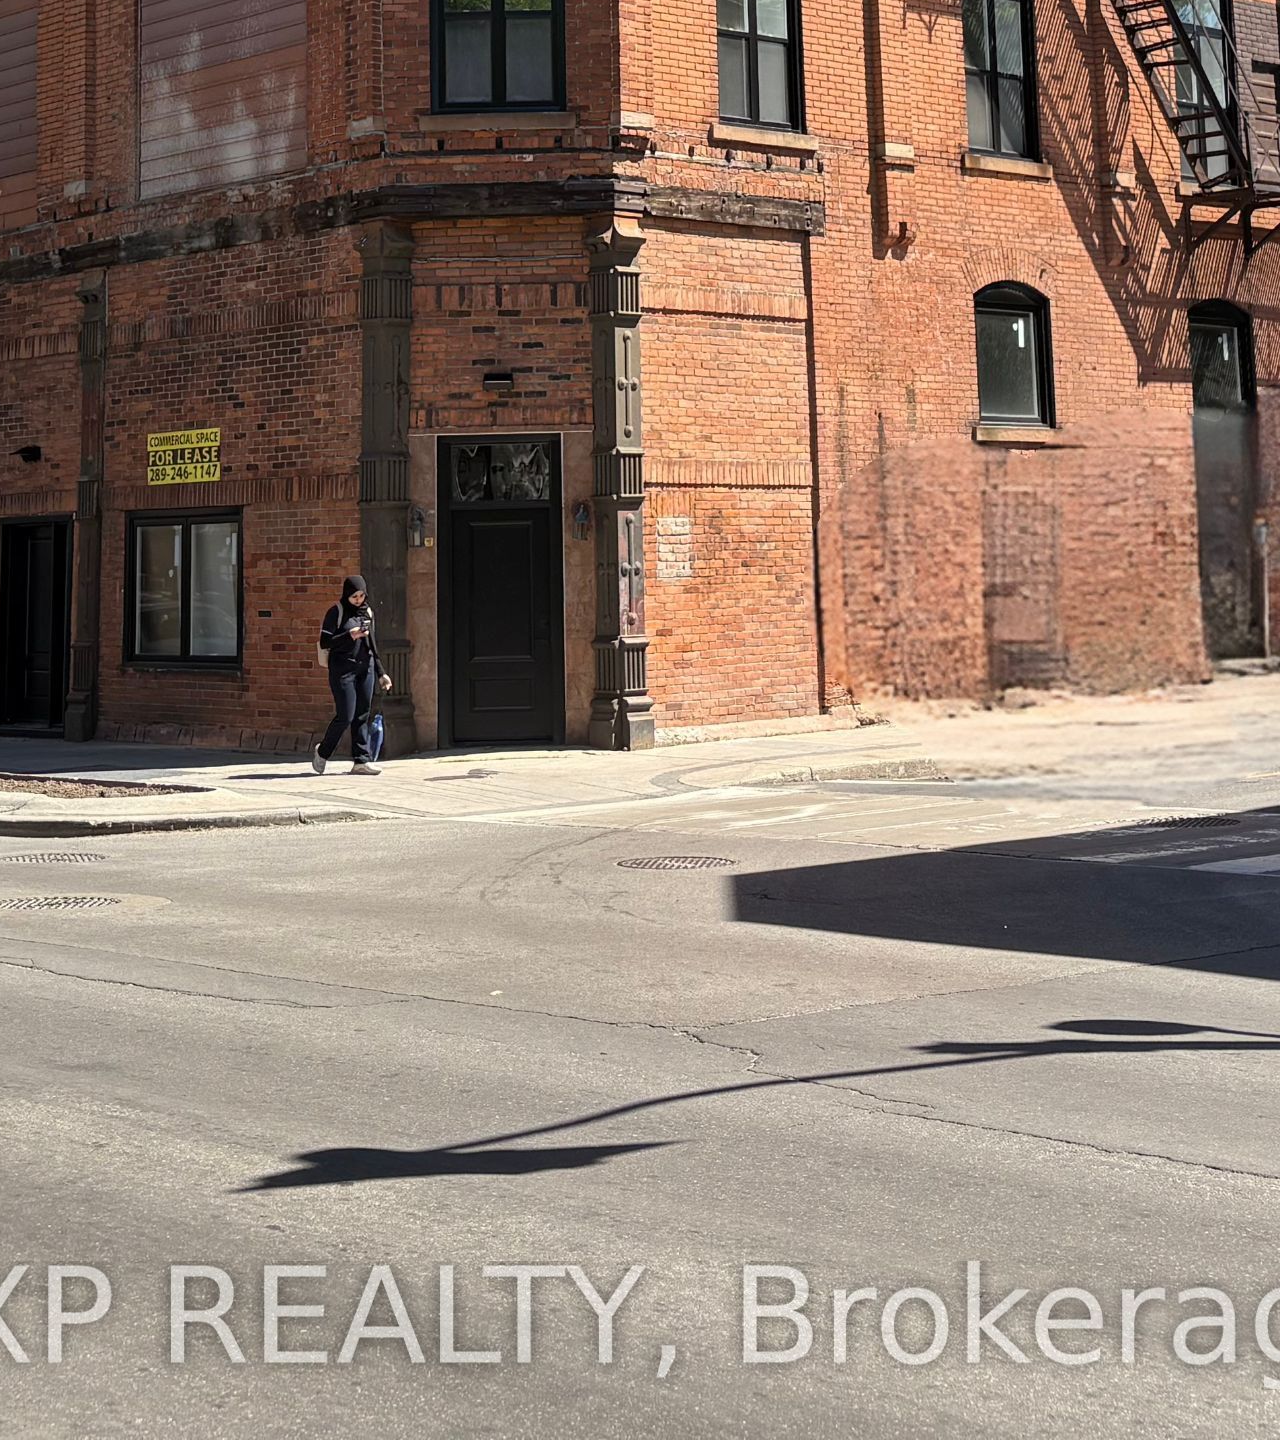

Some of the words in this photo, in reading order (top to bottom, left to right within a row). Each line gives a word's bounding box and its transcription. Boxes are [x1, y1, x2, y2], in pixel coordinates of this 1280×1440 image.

[149, 433, 195, 448] COMMERCIAL
[195, 431, 219, 444] SPACE
[149, 450, 174, 466] FOR
[177, 446, 219, 464] LEASE
[149, 463, 218, 482] 289-246-1147
